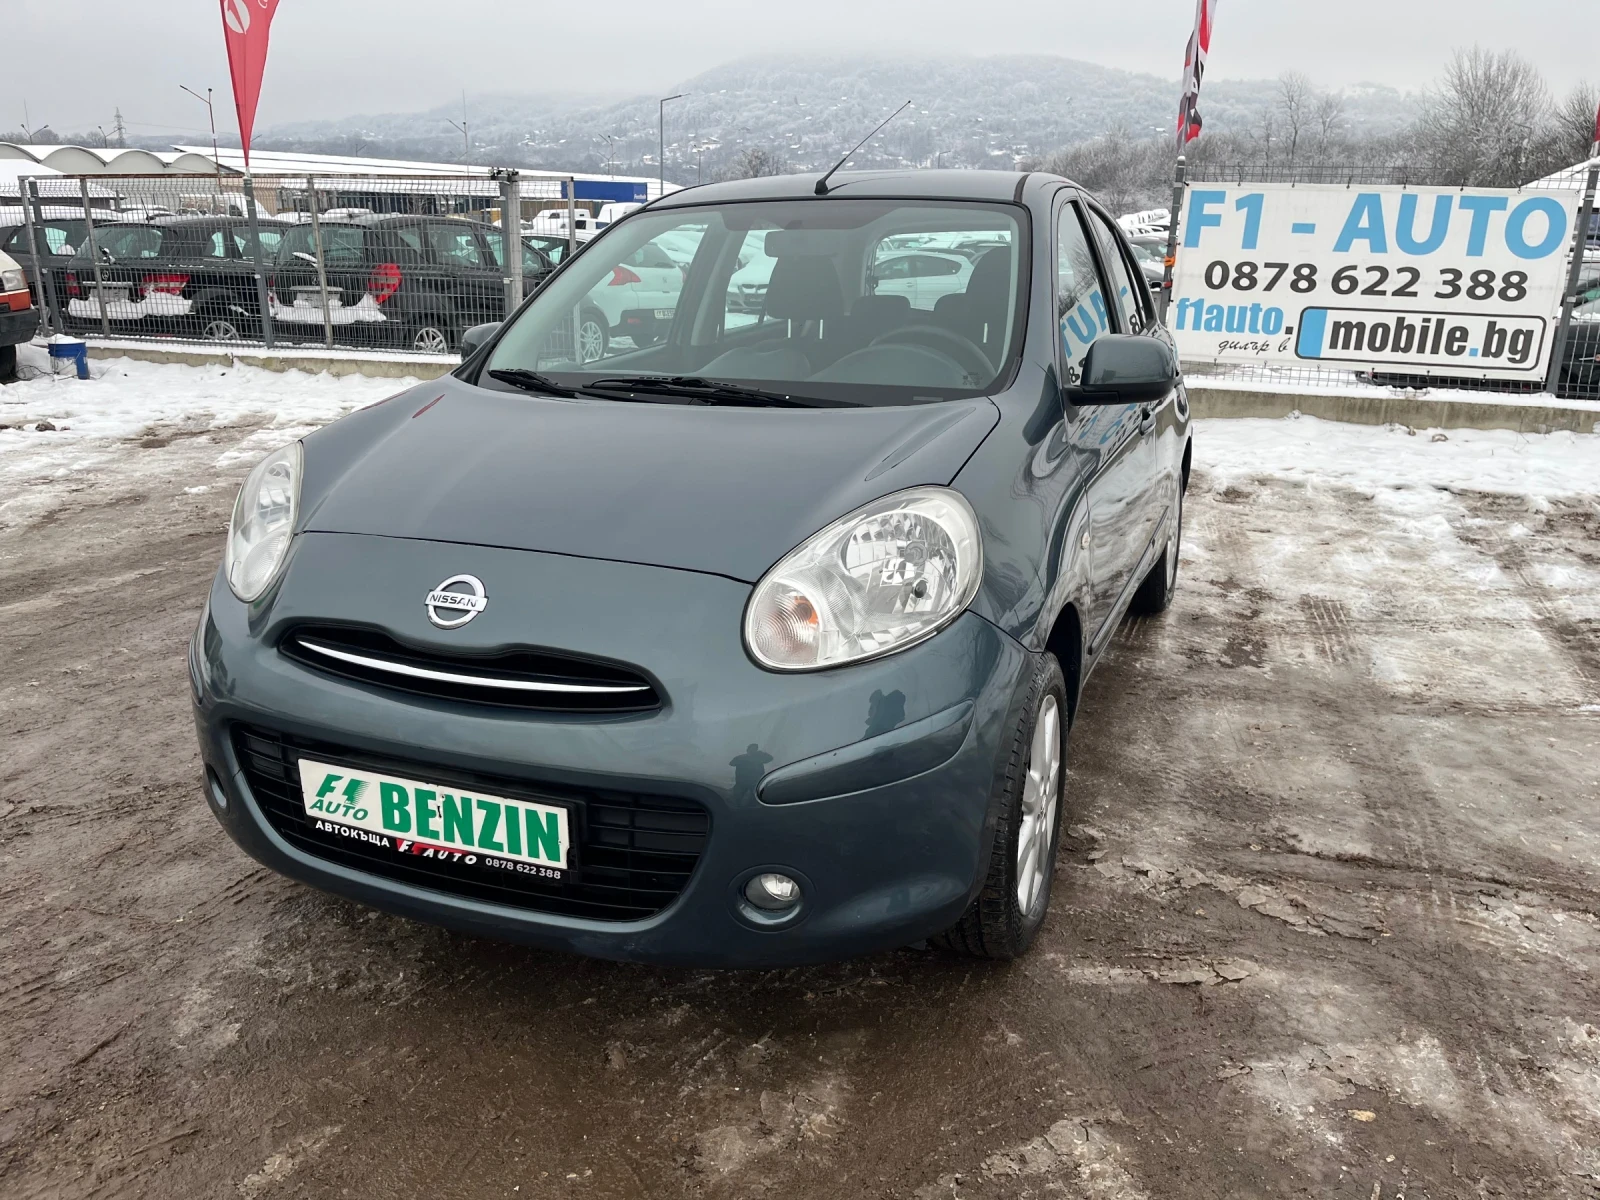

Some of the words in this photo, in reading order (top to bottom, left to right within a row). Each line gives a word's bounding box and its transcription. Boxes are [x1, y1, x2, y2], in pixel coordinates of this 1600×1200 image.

[1183, 190, 1264, 249] F1
[1332, 193, 1567, 259] AUTO
[1204, 260, 1318, 293] 0878
[1330, 264, 1421, 297] 622
[1434, 268, 1529, 302] 388
[1328, 316, 1535, 364] mobile.bg
[429, 594, 478, 608] NISSAN
[309, 799, 369, 821] AUTO
[379, 781, 561, 863] BENZIN
[315, 820, 390, 848] АВТОКЪЩА
[422, 848, 477, 865] AUTO
[485, 858, 514, 870] 0878
[516, 863, 537, 875] 622
[538, 868, 561, 880] 388
